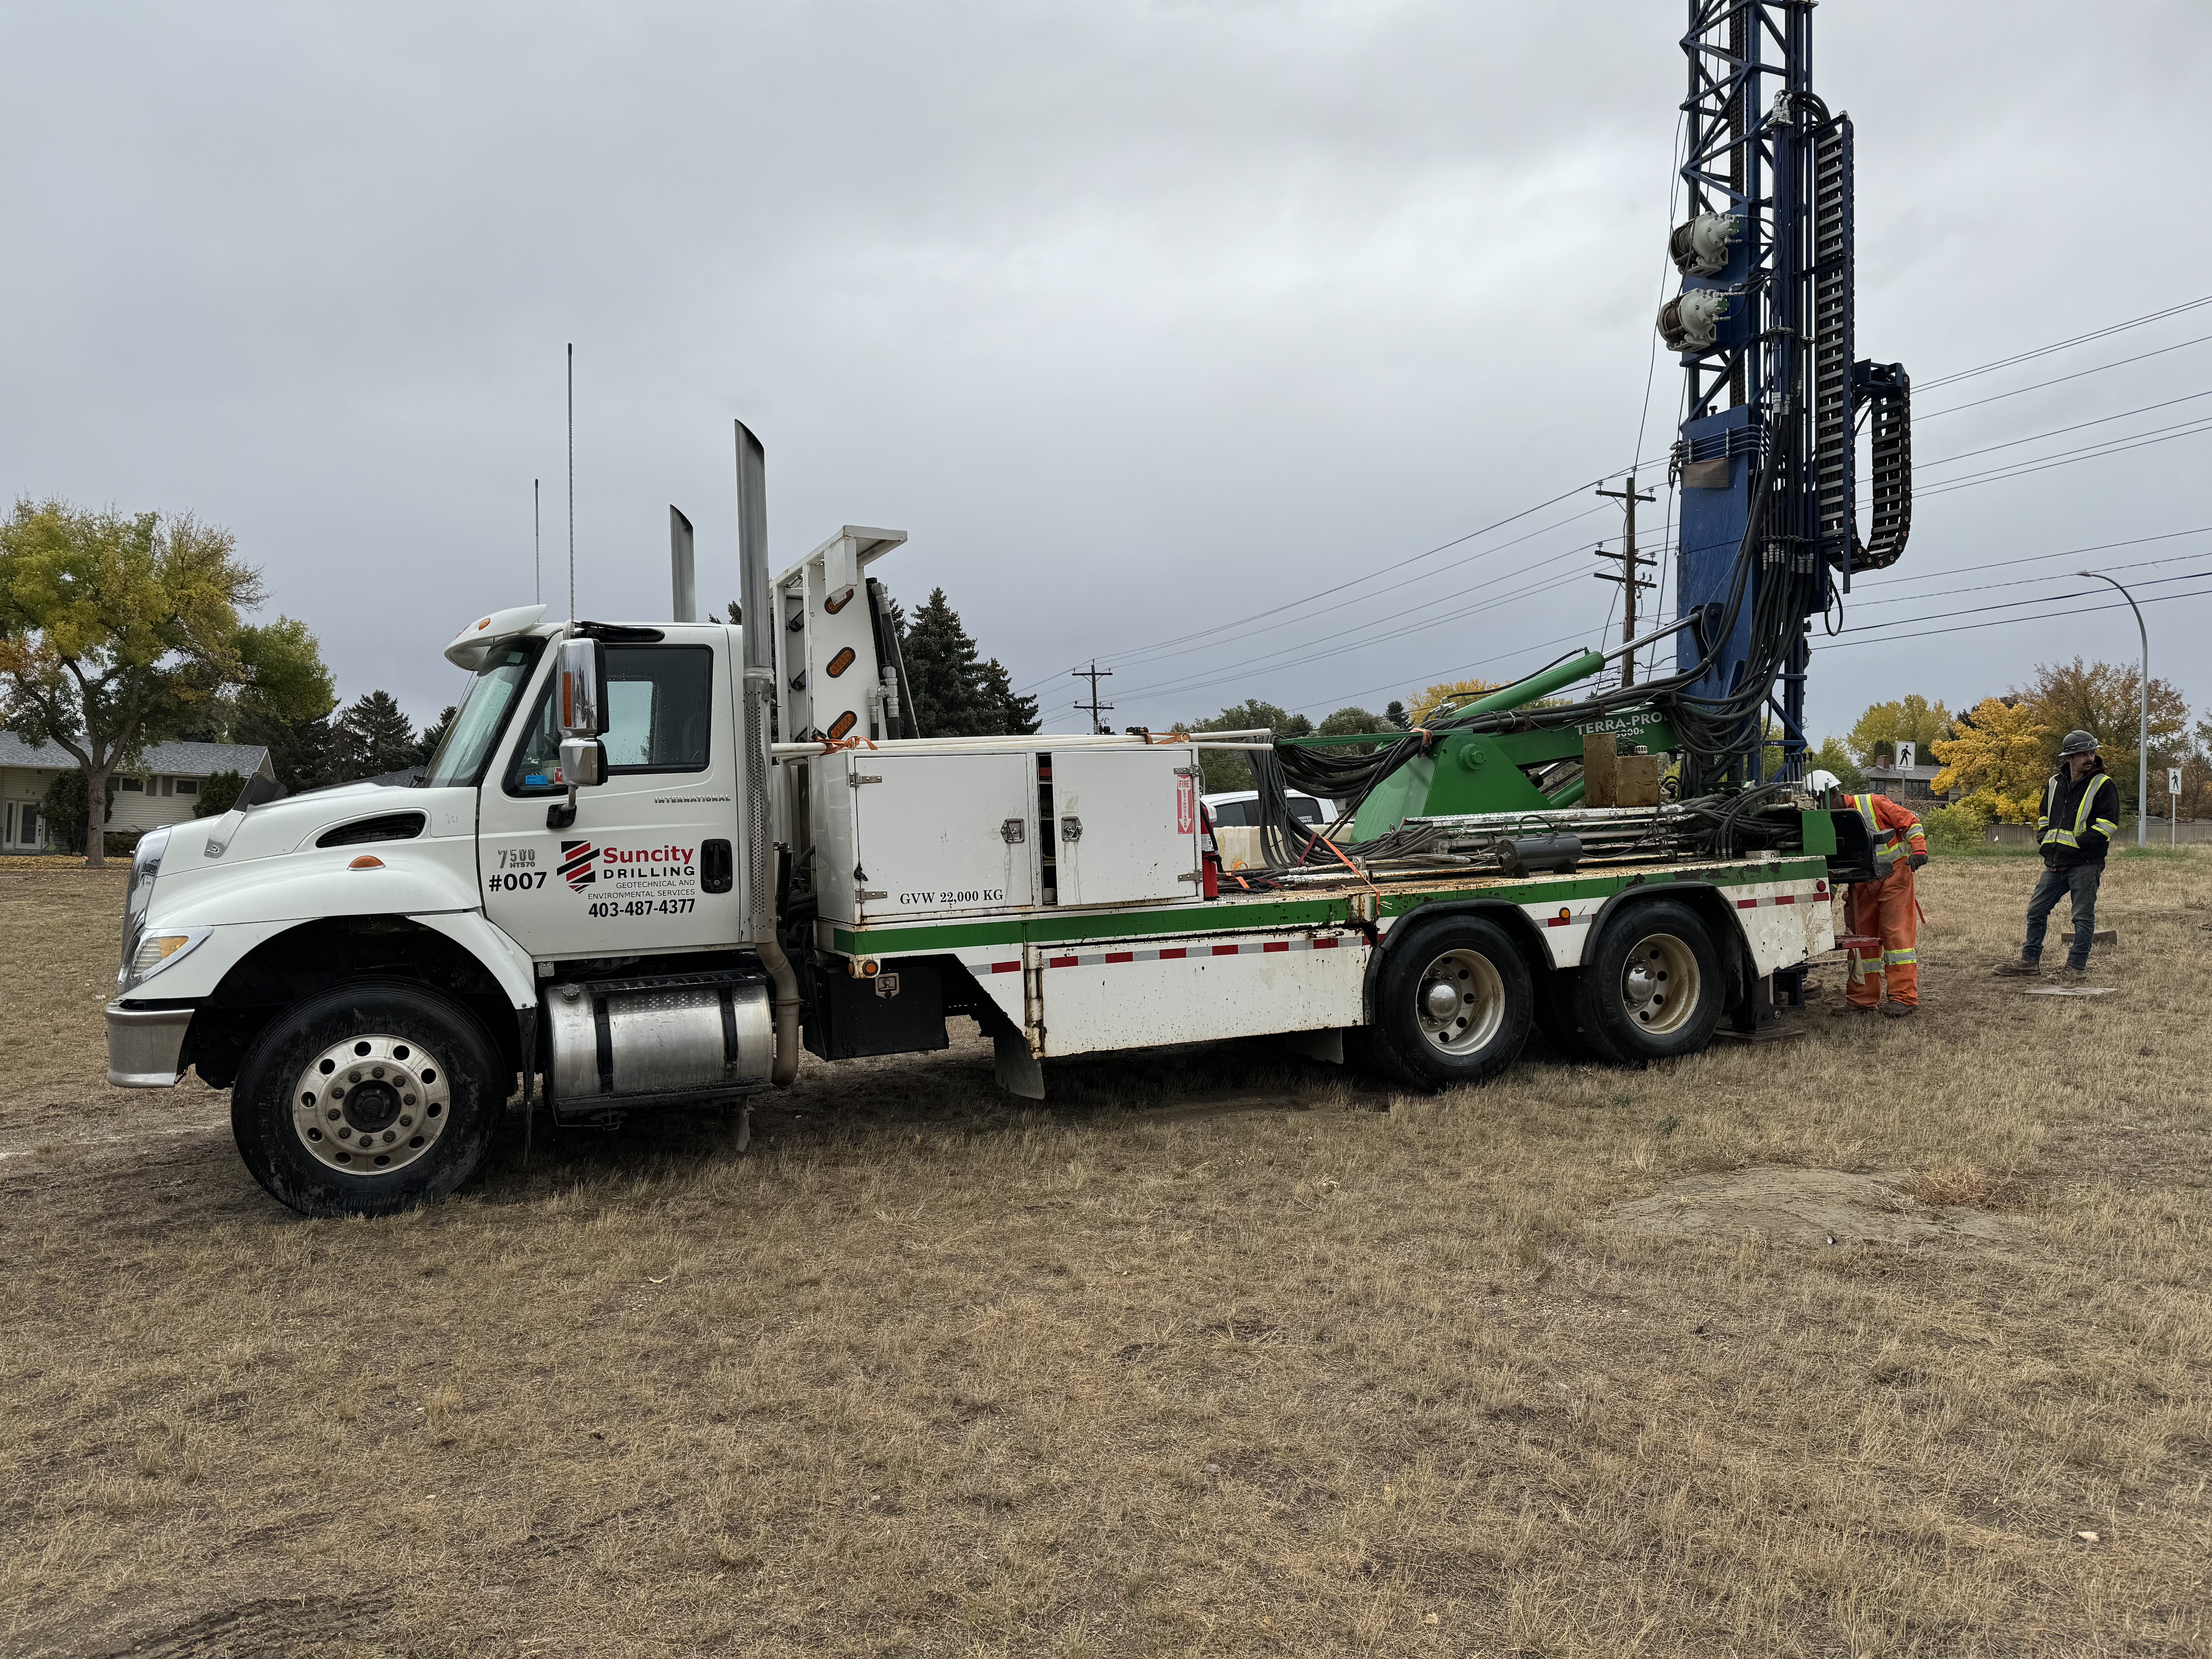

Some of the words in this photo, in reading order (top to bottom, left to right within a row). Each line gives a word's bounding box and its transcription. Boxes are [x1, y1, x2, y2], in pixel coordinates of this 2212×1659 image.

[1179, 780, 1190, 788] FIRE
[654, 794, 730, 803] INTERNATIONAL
[498, 849, 535, 869] 7500
[603, 845, 694, 864] Suncity
[604, 866, 695, 879] DRILLING
[489, 871, 547, 891] #007
[588, 891, 655, 899] ENVIRONMENTAL
[900, 892, 935, 905] GVW
[940, 891, 979, 904] 22,000
[983, 889, 1003, 900] KG
[589, 898, 695, 918] 403-487-4377
